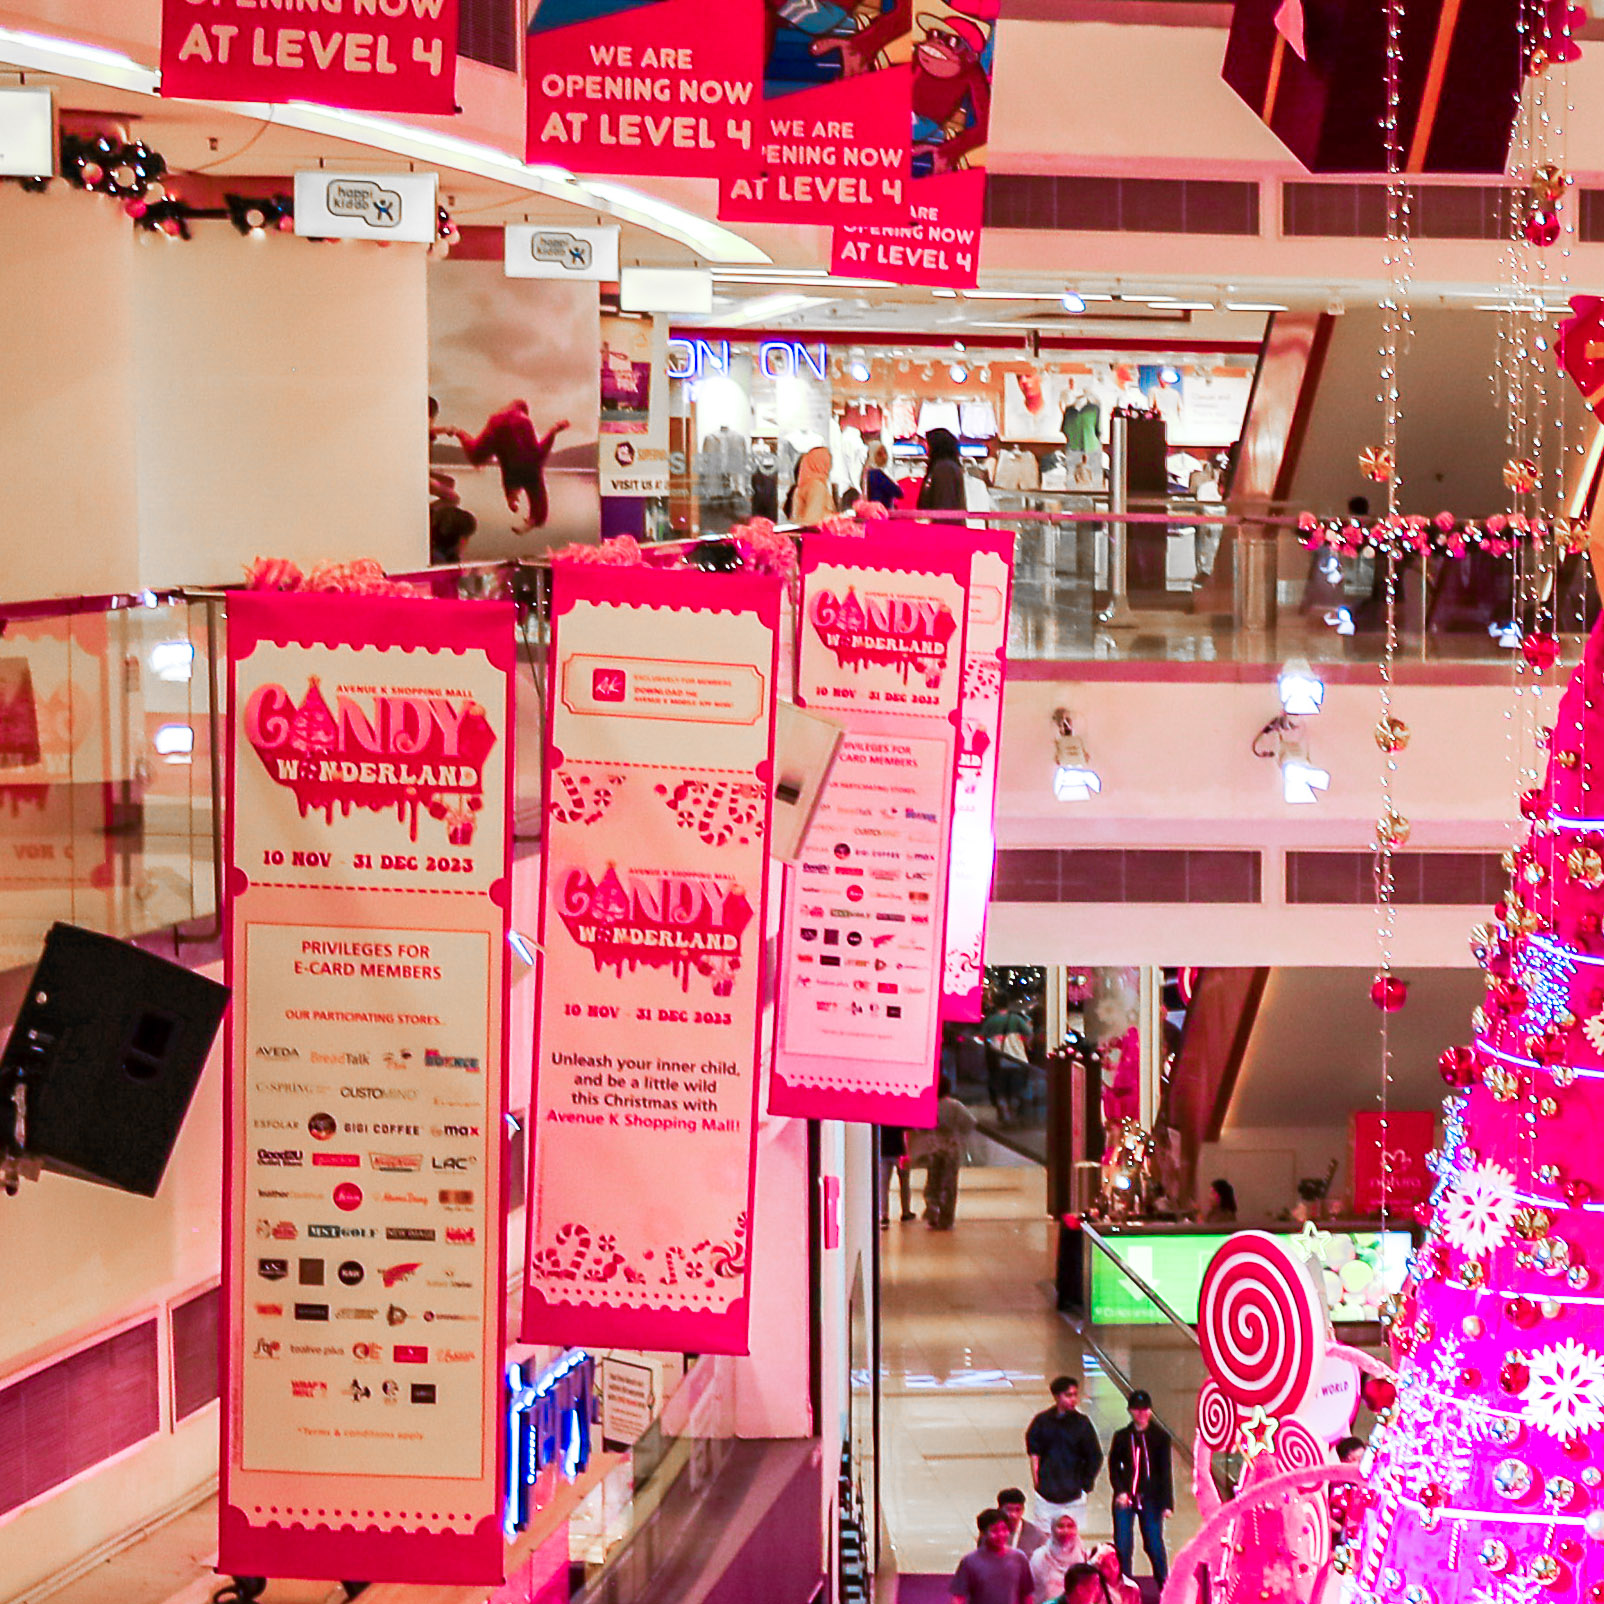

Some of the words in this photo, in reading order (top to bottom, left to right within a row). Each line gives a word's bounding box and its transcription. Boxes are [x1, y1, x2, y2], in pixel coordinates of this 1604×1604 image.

[179, 23, 238, 63] AT
[253, 29, 398, 74] LEVEL
[412, 37, 443, 76] 4
[590, 45, 632, 68] WE
[641, 48, 693, 70] ARE
[541, 74, 671, 101] OPENING
[679, 80, 753, 105] NOW
[541, 112, 587, 143] AT
[600, 115, 716, 150] LEVEL
[727, 119, 751, 151] 4
[771, 120, 805, 138] WE
[812, 121, 854, 140] ARE
[843, 146, 903, 168] NOW
[730, 177, 768, 201] AT
[779, 178, 873, 205] LEVEL
[883, 180, 902, 206] 4
[928, 226, 974, 246] NOW
[841, 241, 872, 262] AT
[877, 245, 951, 271] LEVEL
[956, 252, 972, 273] 4
[760, 340, 828, 381] ON
[611, 480, 639, 492] VISIT
[262, 850, 284, 867] 10
[292, 851, 332, 868] NOV
[353, 853, 374, 870] 31
[381, 854, 419, 871] DEC
[426, 856, 474, 873] 2023
[300, 940, 393, 960] PRIVILEGES
[397, 943, 431, 960] FOR
[294, 961, 356, 980] E-CARD
[360, 963, 442, 981] MEMBERS
[310, 1010, 395, 1025] PARTICIPATING
[564, 1004, 582, 1016] 10
[588, 1005, 619, 1019] NOV
[636, 1009, 653, 1020] 31
[659, 1010, 689, 1022] DEC
[695, 1011, 733, 1025] 2023
[256, 1046, 300, 1058] AVEDA
[551, 1052, 613, 1069] Unleash
[617, 1059, 652, 1074] your
[657, 1059, 695, 1073] inner
[701, 1060, 741, 1077] child,
[574, 1073, 602, 1088] and
[608, 1074, 627, 1089] be
[631, 1079, 640, 1090] a
[644, 1075, 679, 1092] little
[684, 1078, 717, 1093] wild
[572, 1091, 599, 1106] this
[603, 1093, 678, 1110] Christmas
[683, 1097, 718, 1112] with
[373, 1124, 420, 1136] COFFEE
[546, 1110, 605, 1126] Avenue
[609, 1113, 619, 1126] K
[624, 1114, 697, 1133] Shopping
[702, 1117, 740, 1133] Mall!
[1321, 1381, 1349, 1396] WORLD
